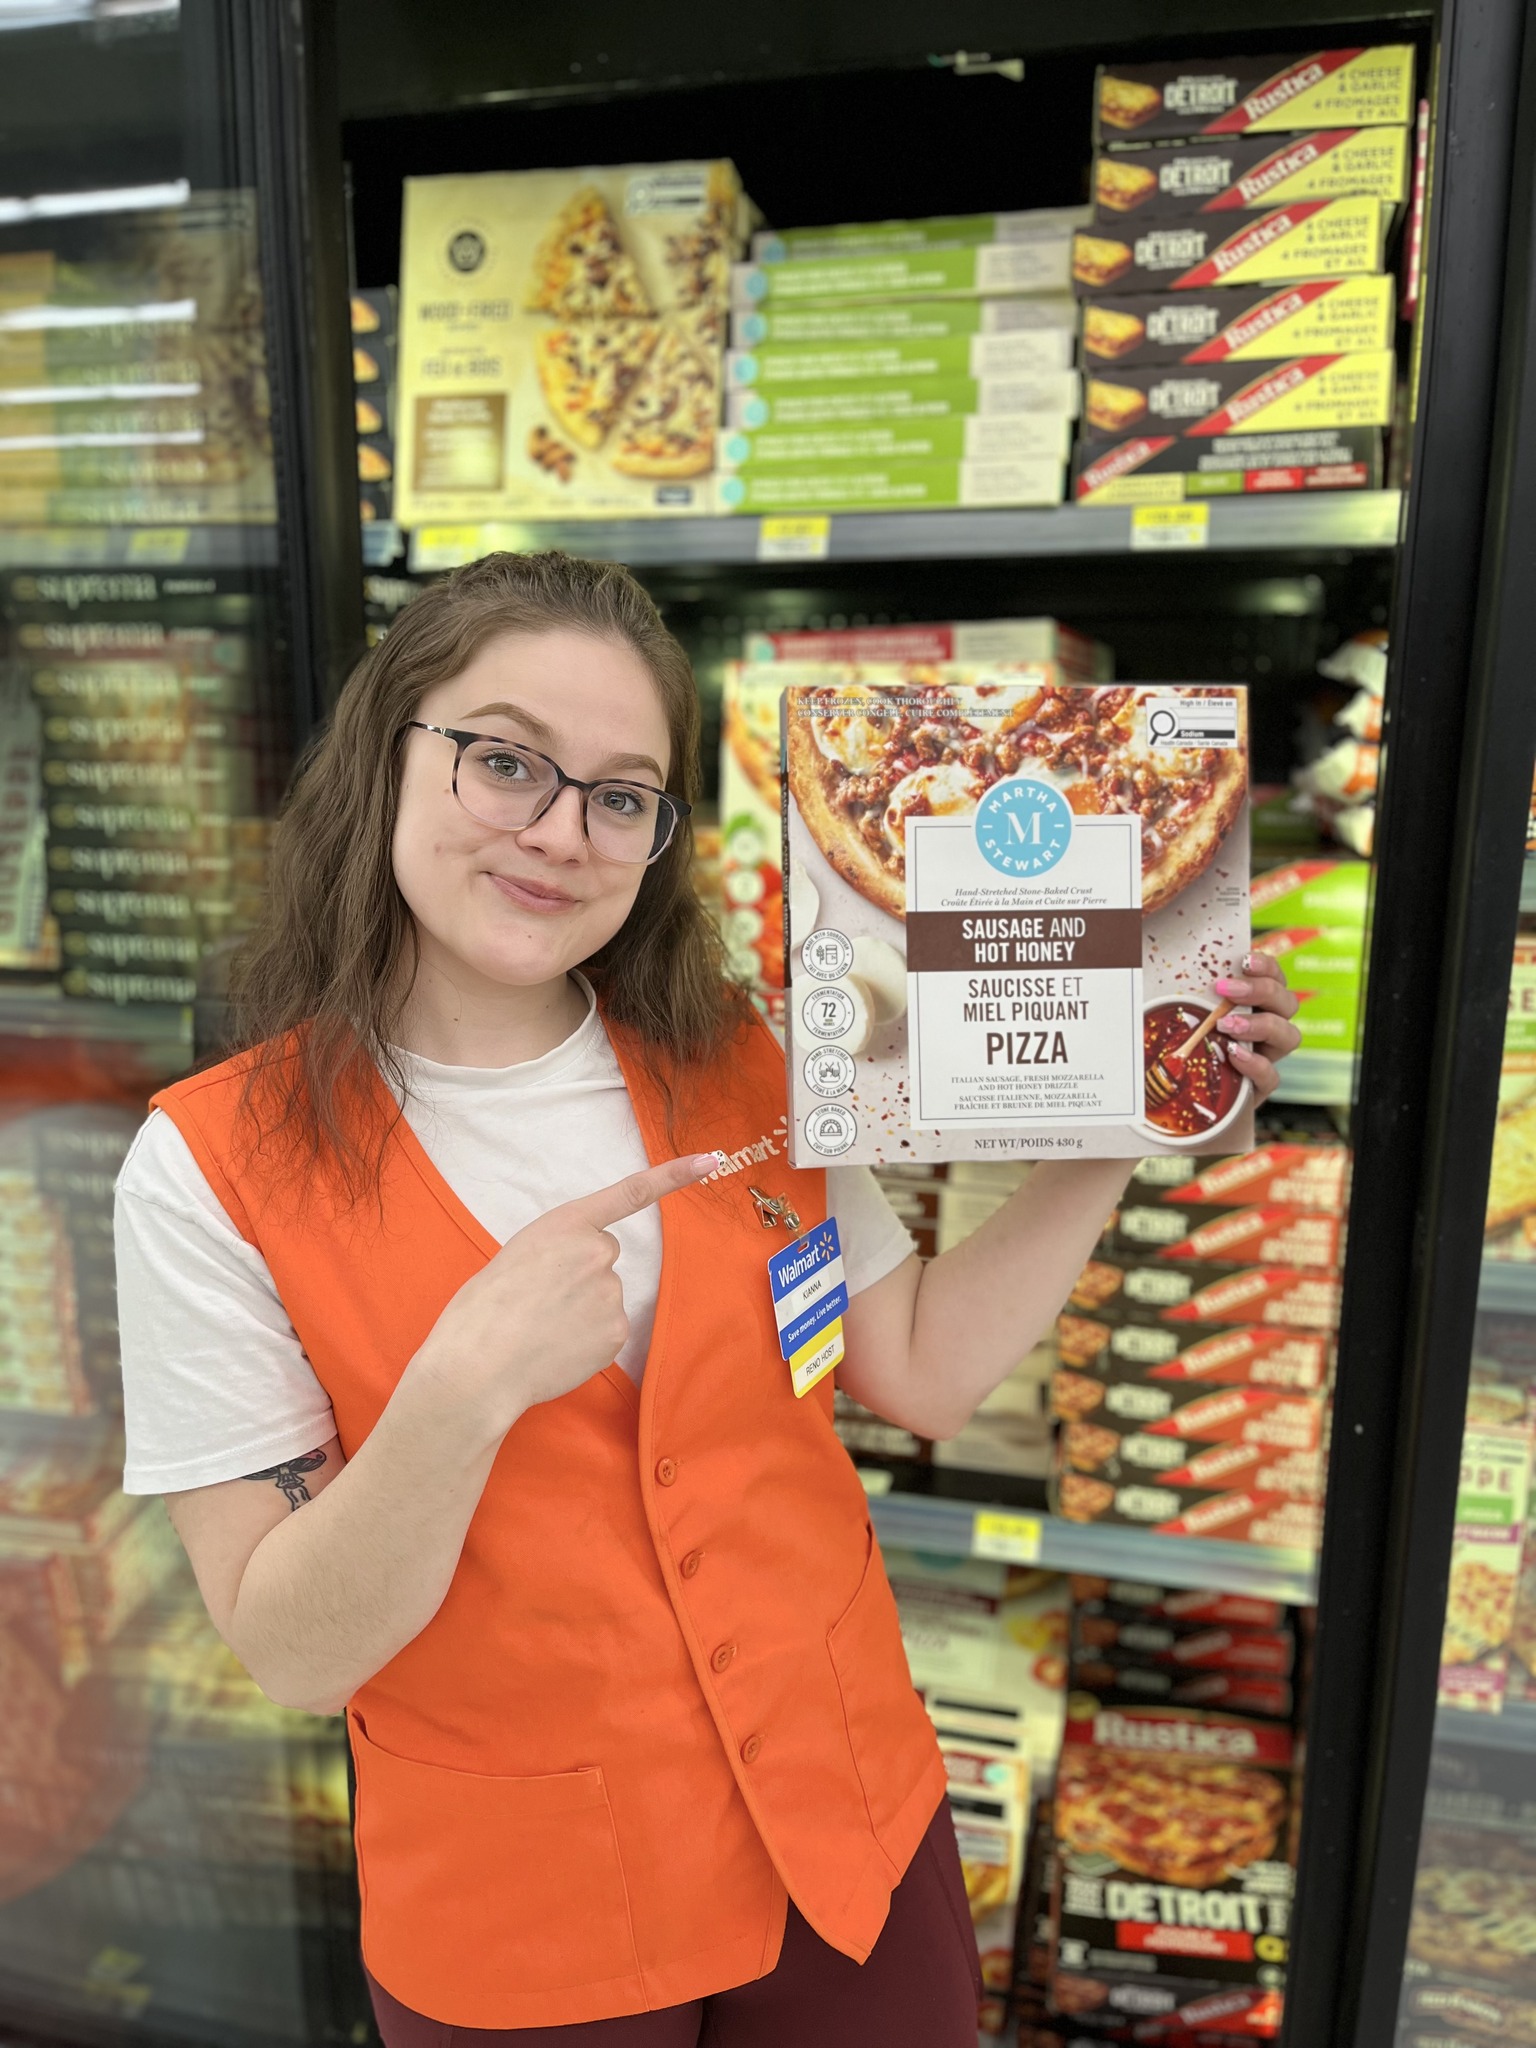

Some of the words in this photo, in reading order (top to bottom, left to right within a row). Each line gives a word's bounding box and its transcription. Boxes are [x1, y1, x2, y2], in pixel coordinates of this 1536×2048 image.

[1347, 65, 1402, 80] CHEESE
[1163, 78, 1239, 109] DETROIT
[1243, 63, 1325, 120] Rustica
[1349, 79, 1401, 93] GARLIC
[1159, 159, 1233, 192] DETROIT
[1238, 143, 1319, 200] Rustica
[1212, 214, 1293, 274] Rustica
[1180, 730, 1205, 738] Sodium
[988, 786, 1057, 814] MARTHA
[1004, 812, 1044, 845] M
[985, 839, 1061, 871] STEWART
[941, 898, 967, 907] Croûte
[994, 898, 1000, 906] à
[1001, 898, 1010, 906] la
[1011, 898, 1033, 906] Main
[1035, 898, 1042, 906] et
[1044, 897, 1065, 905] Cuite
[1082, 897, 1107, 905] Pierre
[955, 888, 1018, 897] Hand-Stretched
[1018, 887, 1069, 896] Stone-Baked
[1070, 887, 1093, 895] Crust
[814, 931, 826, 940] WITH
[962, 917, 1044, 940] SAUSAGE
[1049, 917, 1086, 938] AND
[974, 942, 1010, 964] HOT
[1015, 941, 1076, 962] HONEY
[811, 989, 845, 1001] FERMENTATION
[968, 977, 1056, 999] SAUCISSE
[1062, 976, 1083, 997] ET
[821, 1002, 836, 1018] 72
[963, 1002, 1006, 1022] MIEL
[1011, 1000, 1089, 1022] PIQUANT
[812, 1026, 845, 1038] FERMENTATION
[810, 1047, 849, 1062] HAND-STRETCHED
[986, 1030, 1069, 1065] PIZZA
[951, 1076, 985, 1084] ITALIAN
[985, 1075, 1023, 1084] SAUSAGE,
[1051, 1074, 1104, 1082] MOZZARELLA
[997, 1083, 1014, 1091] HOT
[1044, 1082, 1079, 1090] DRIZZLE
[954, 1101, 989, 1110] FRAÎCHE
[1068, 1100, 1103, 1109] PIQUANT
[997, 1093, 1043, 1102] ITALIENNE,
[1044, 1092, 1097, 1100] MOZZARELLA
[815, 1106, 830, 1117] STONE
[831, 1106, 846, 1116] BAKED
[974, 1139, 997, 1149] NET
[998, 1138, 1054, 1150] WT/POIDS
[1056, 1138, 1075, 1148] 430
[1076, 1139, 1083, 1149] g
[699, 1135, 781, 1186] almart
[778, 1245, 820, 1287] Walmart
[802, 1280, 822, 1301] KIANNA
[787, 1328, 800, 1343] Save
[800, 1315, 817, 1335] money.
[815, 1307, 826, 1320] Live
[825, 1295, 842, 1313] better.
[805, 1357, 821, 1376] RENO
[821, 1344, 835, 1362] HOST
[1093, 1711, 1258, 1757] Rustica
[1105, 1880, 1263, 1934] DETROIT
